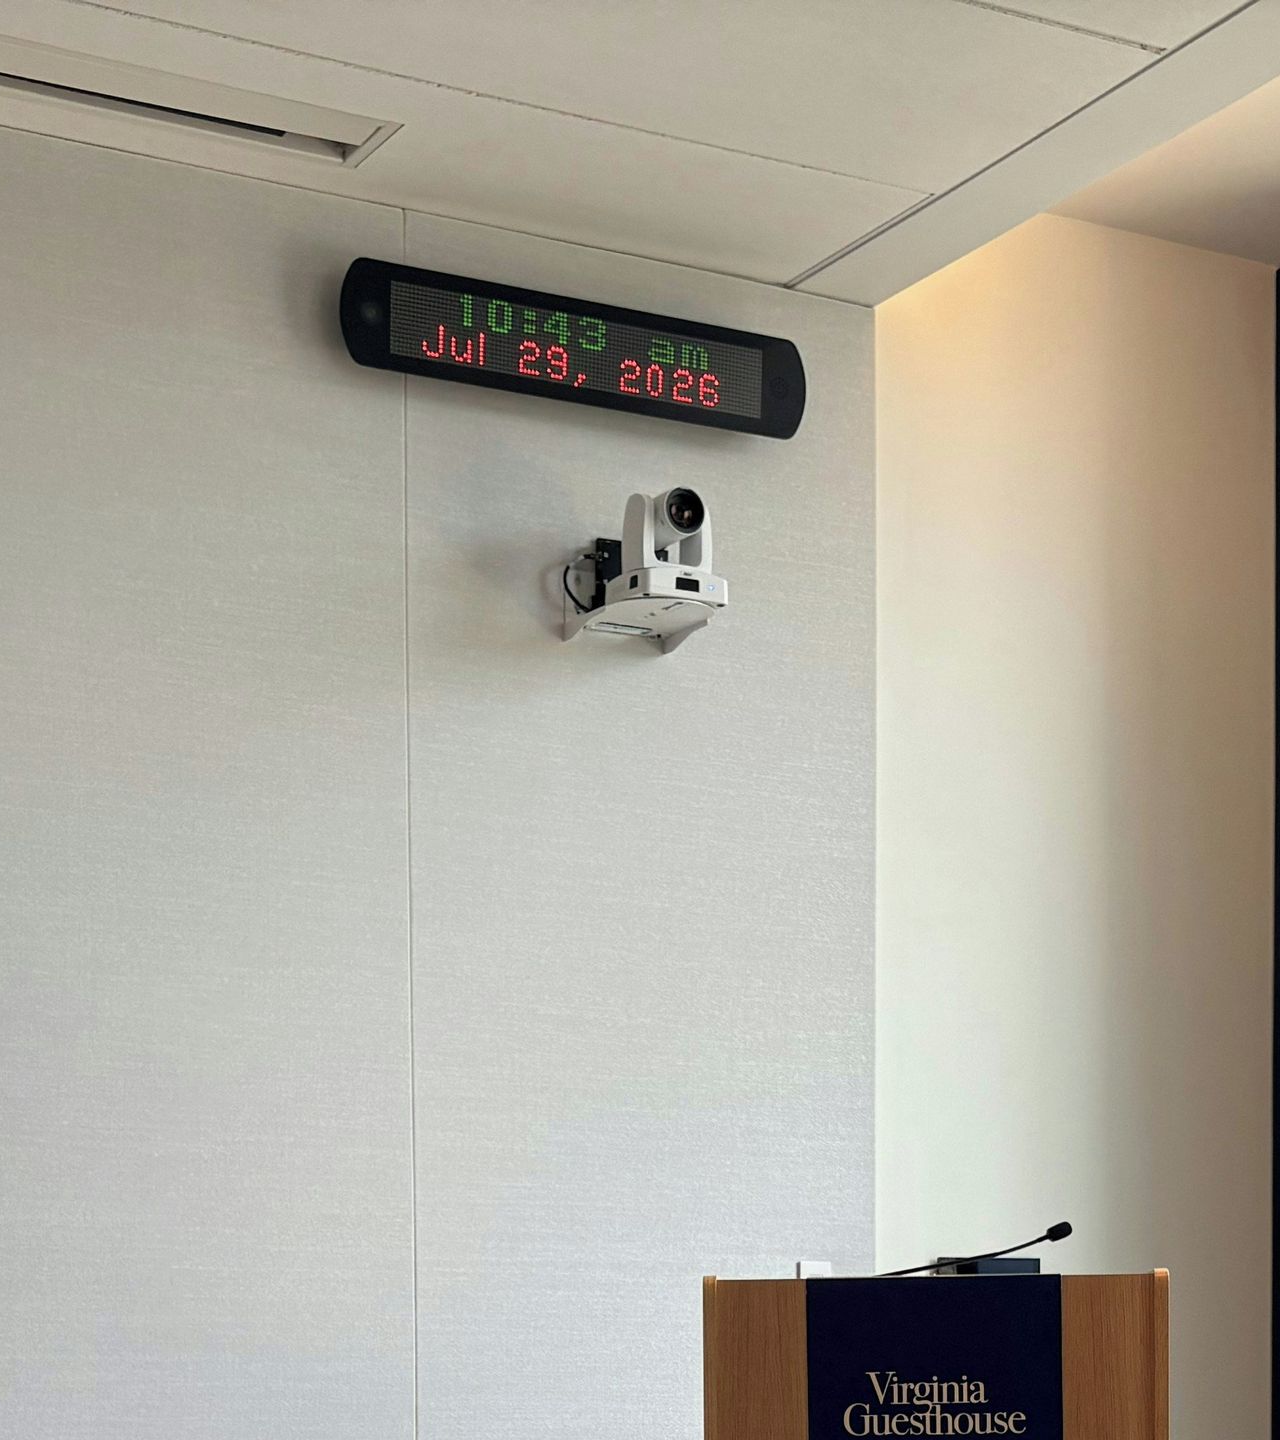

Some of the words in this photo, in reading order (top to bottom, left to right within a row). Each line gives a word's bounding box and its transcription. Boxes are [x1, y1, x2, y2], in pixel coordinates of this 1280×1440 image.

[459, 294, 608, 352] 10:43
[648, 338, 710, 371] am
[421, 324, 487, 366] Jul
[517, 340, 588, 388] 29,
[619, 359, 721, 408] 2026
[843, 1402, 1027, 1437] Guesthouse
[865, 1371, 989, 1414] Virginia
